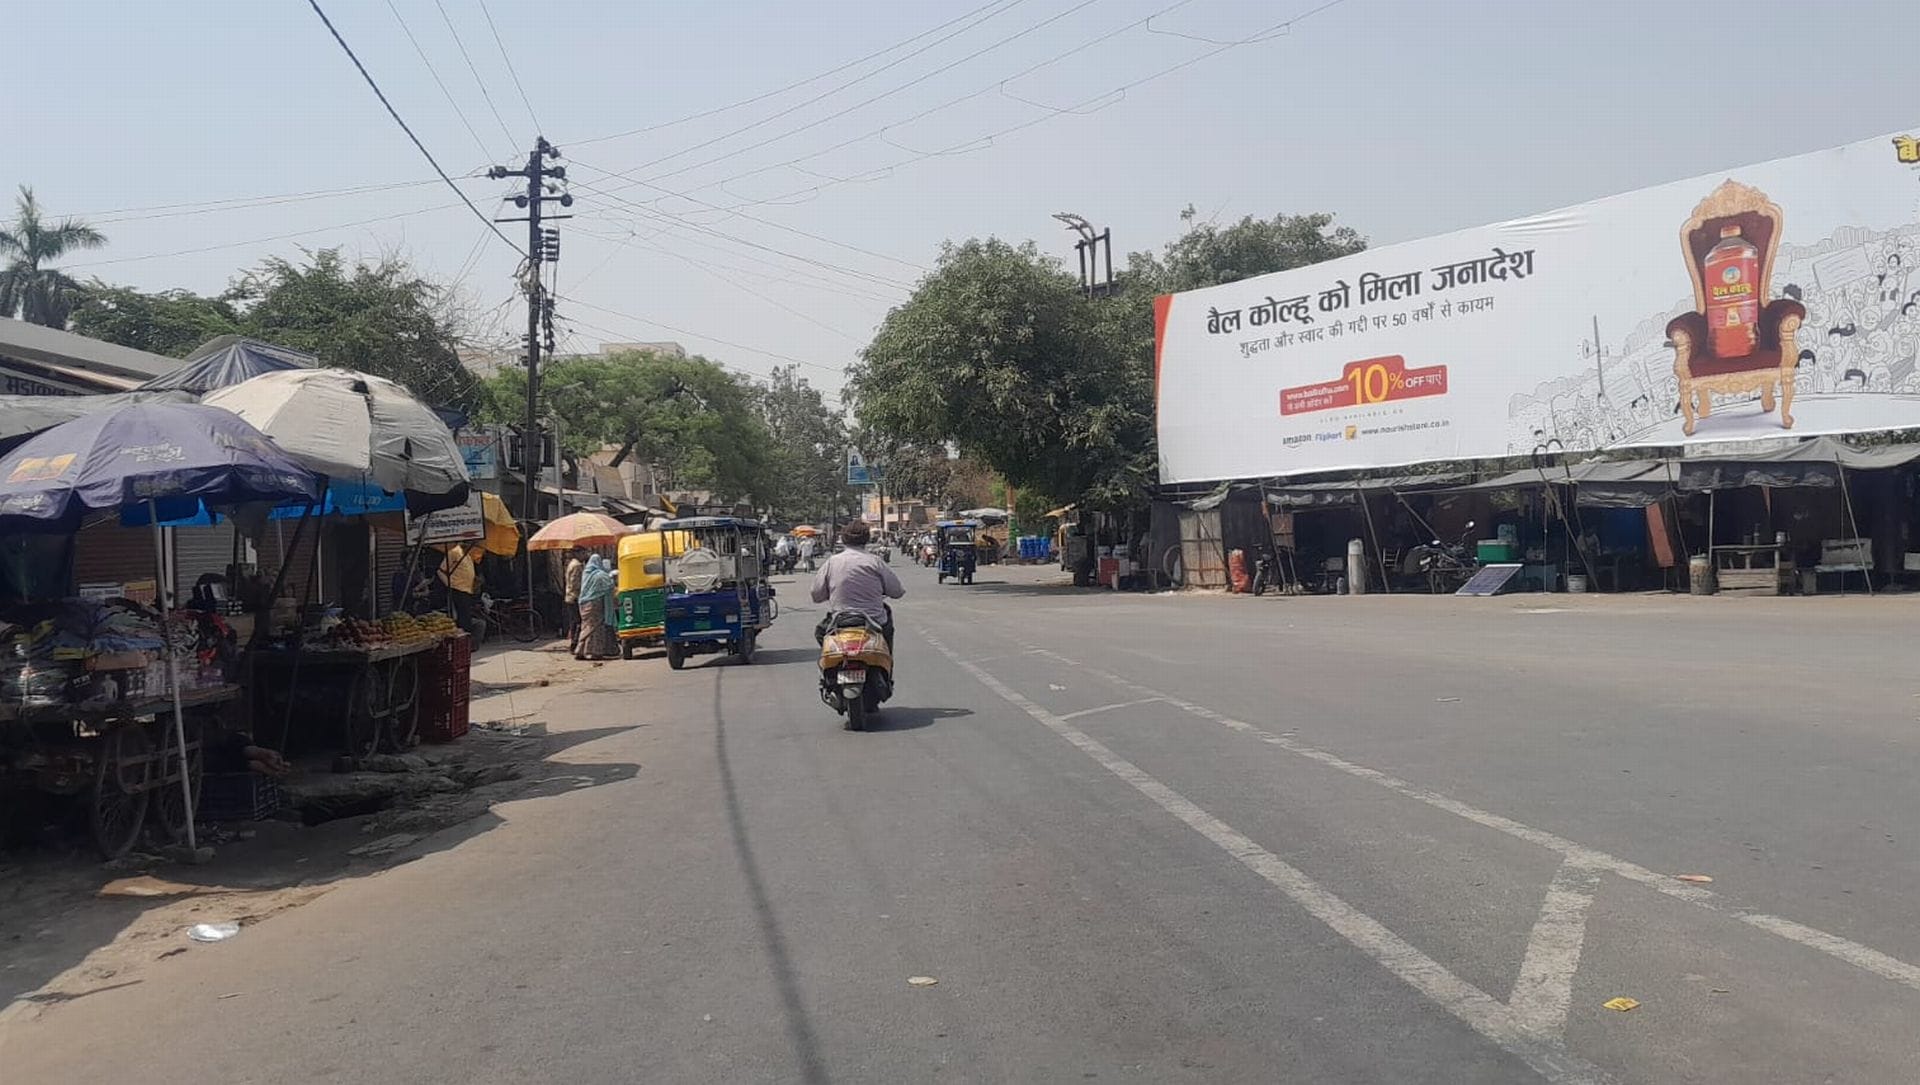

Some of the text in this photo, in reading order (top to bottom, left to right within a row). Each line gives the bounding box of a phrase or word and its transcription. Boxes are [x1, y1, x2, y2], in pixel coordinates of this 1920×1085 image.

[1207, 248, 1535, 334] बैल कोल्हू को मिला जनादेश
[1240, 296, 1494, 358] शुद्धता और स्वाद की गद्दी पर 50 वर्षों से कायम
[1348, 363, 1442, 405] 10% OFF पाएं
[1282, 434, 1312, 445] amazon
